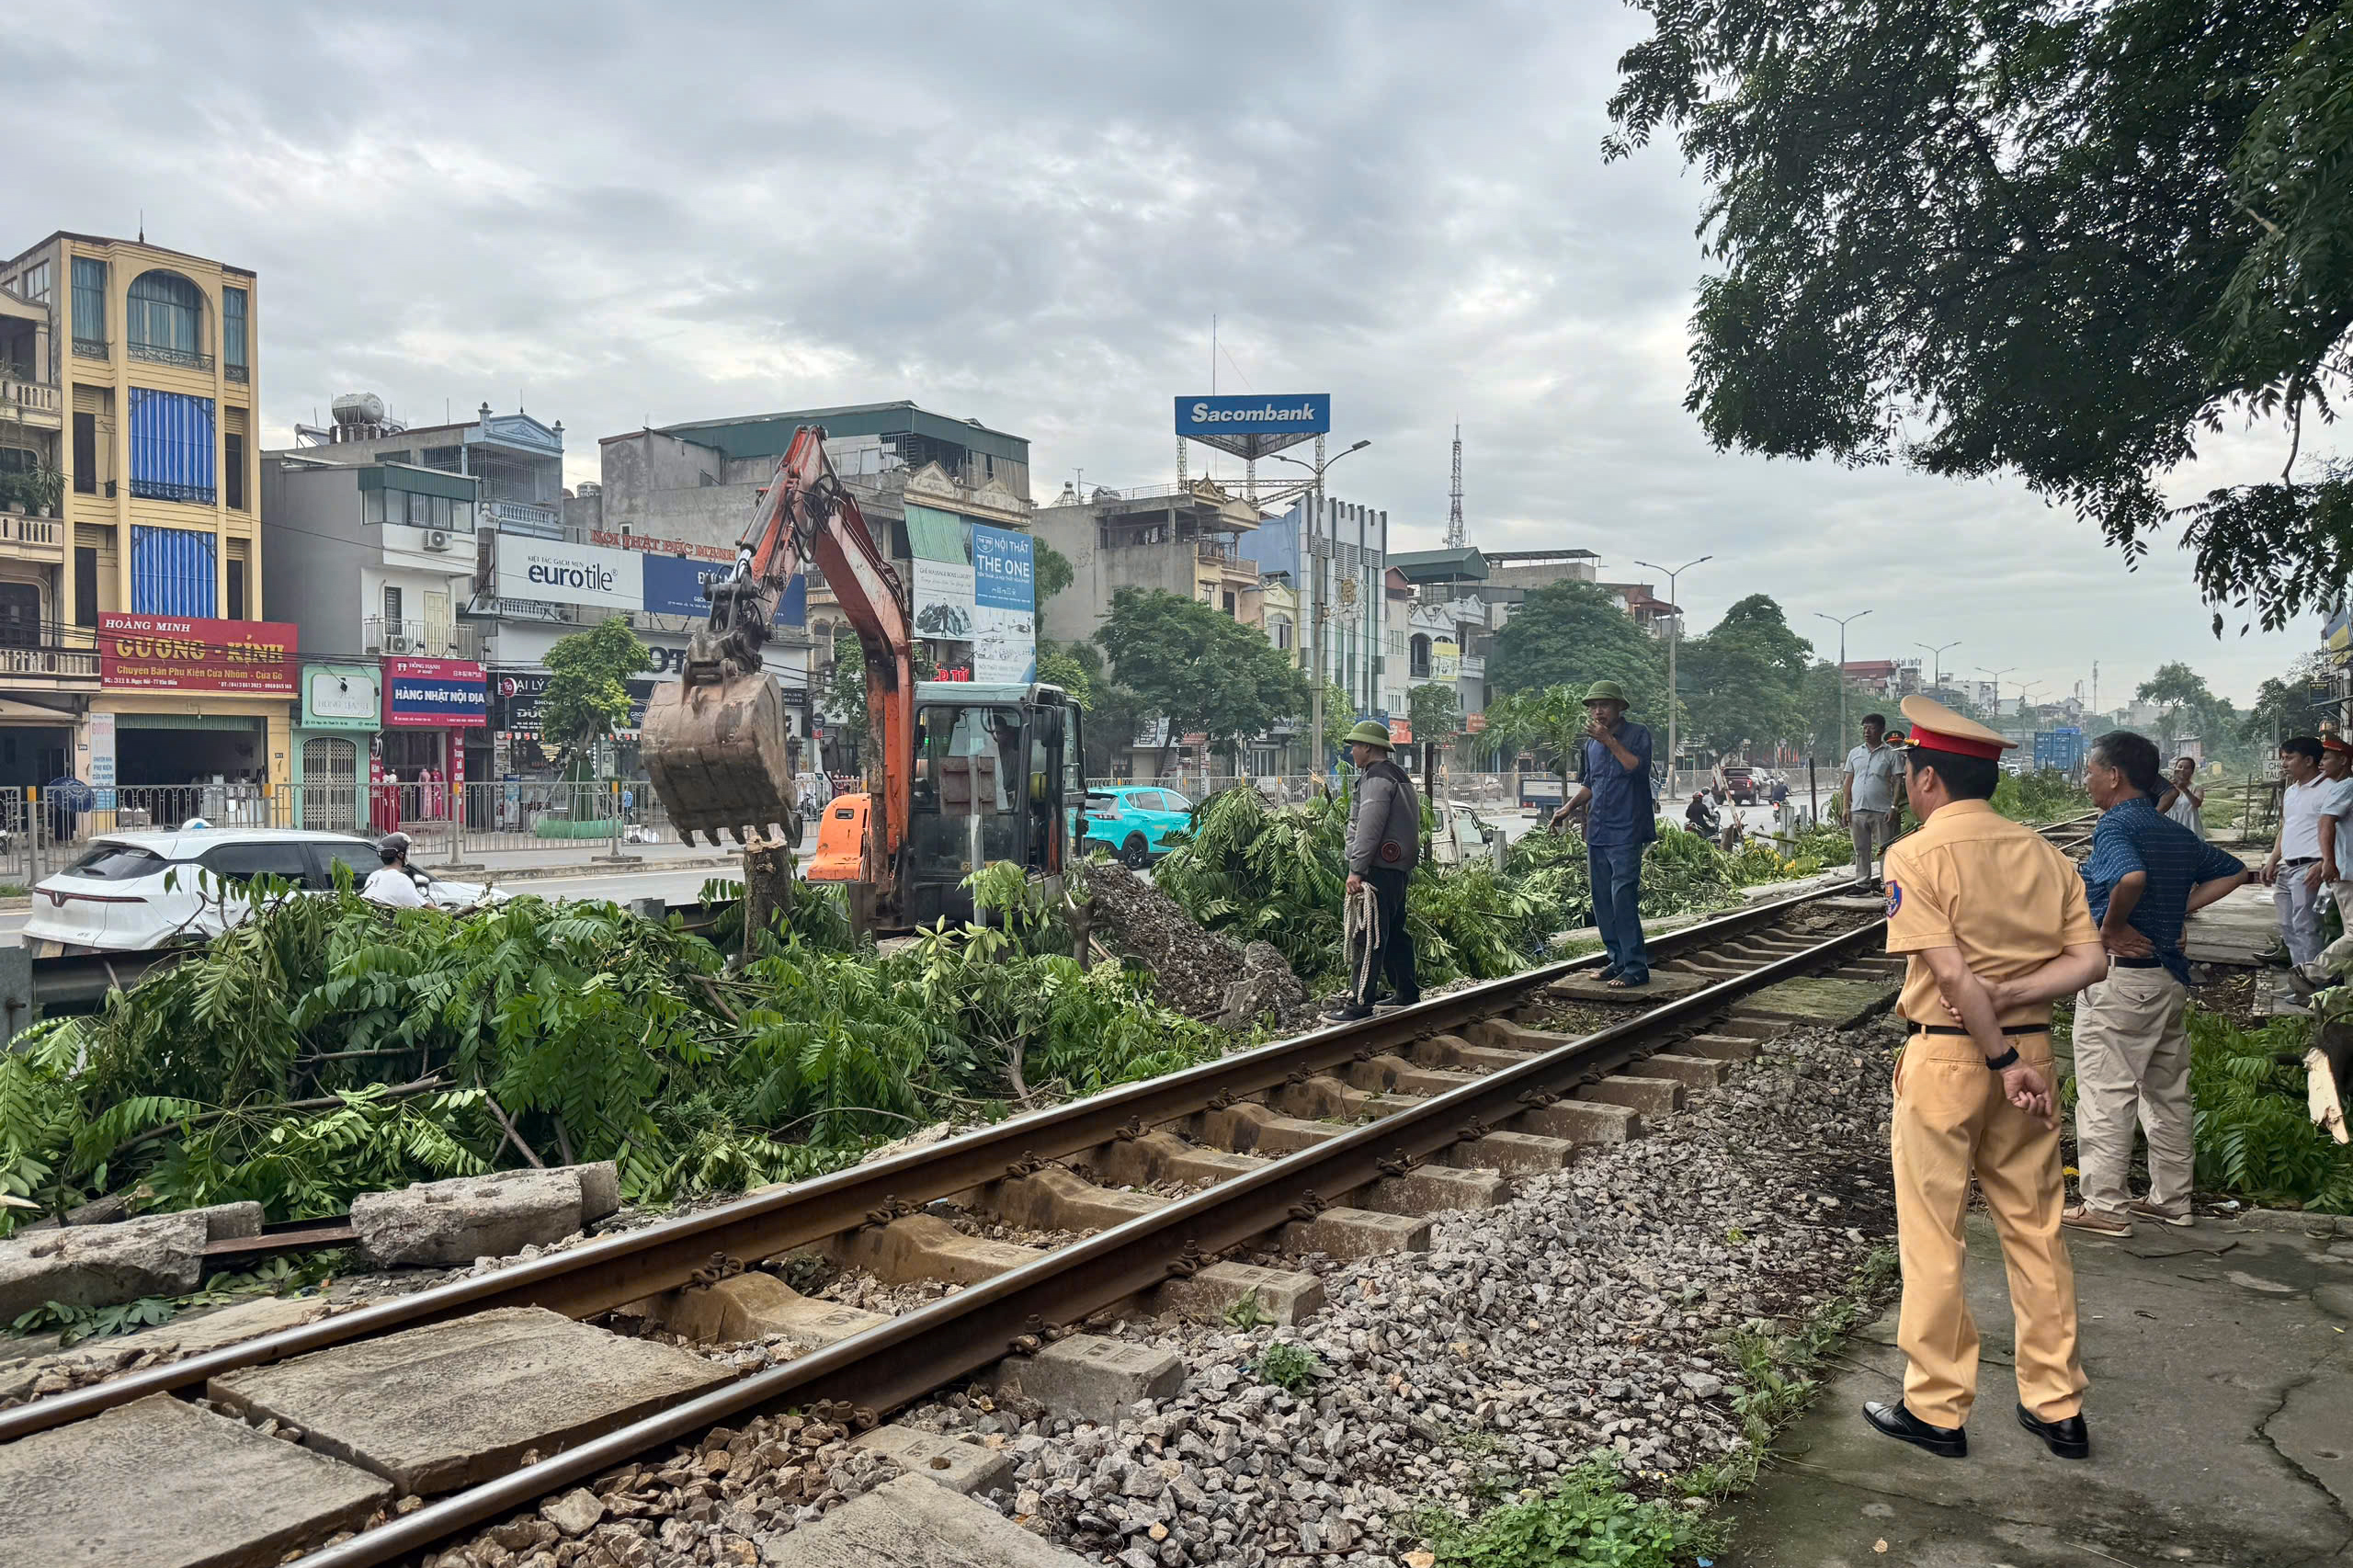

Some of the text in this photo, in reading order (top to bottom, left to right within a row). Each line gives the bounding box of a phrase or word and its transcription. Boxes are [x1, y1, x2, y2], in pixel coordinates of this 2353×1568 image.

[1191, 403, 1315, 423] Sacombank
[995, 537, 1029, 553] NỘI THẤT
[977, 554, 1029, 578] THE ONE
[529, 563, 612, 591] eurotile
[105, 617, 191, 632] HOÀNG MINH
[116, 636, 205, 661] GƯƠNG
[227, 634, 285, 664] KÍNH
[168, 668, 185, 678] Phụ
[531, 678, 545, 690] LÝ
[395, 686, 485, 705] HÀNG NHẬT NỘI ĐỊA
